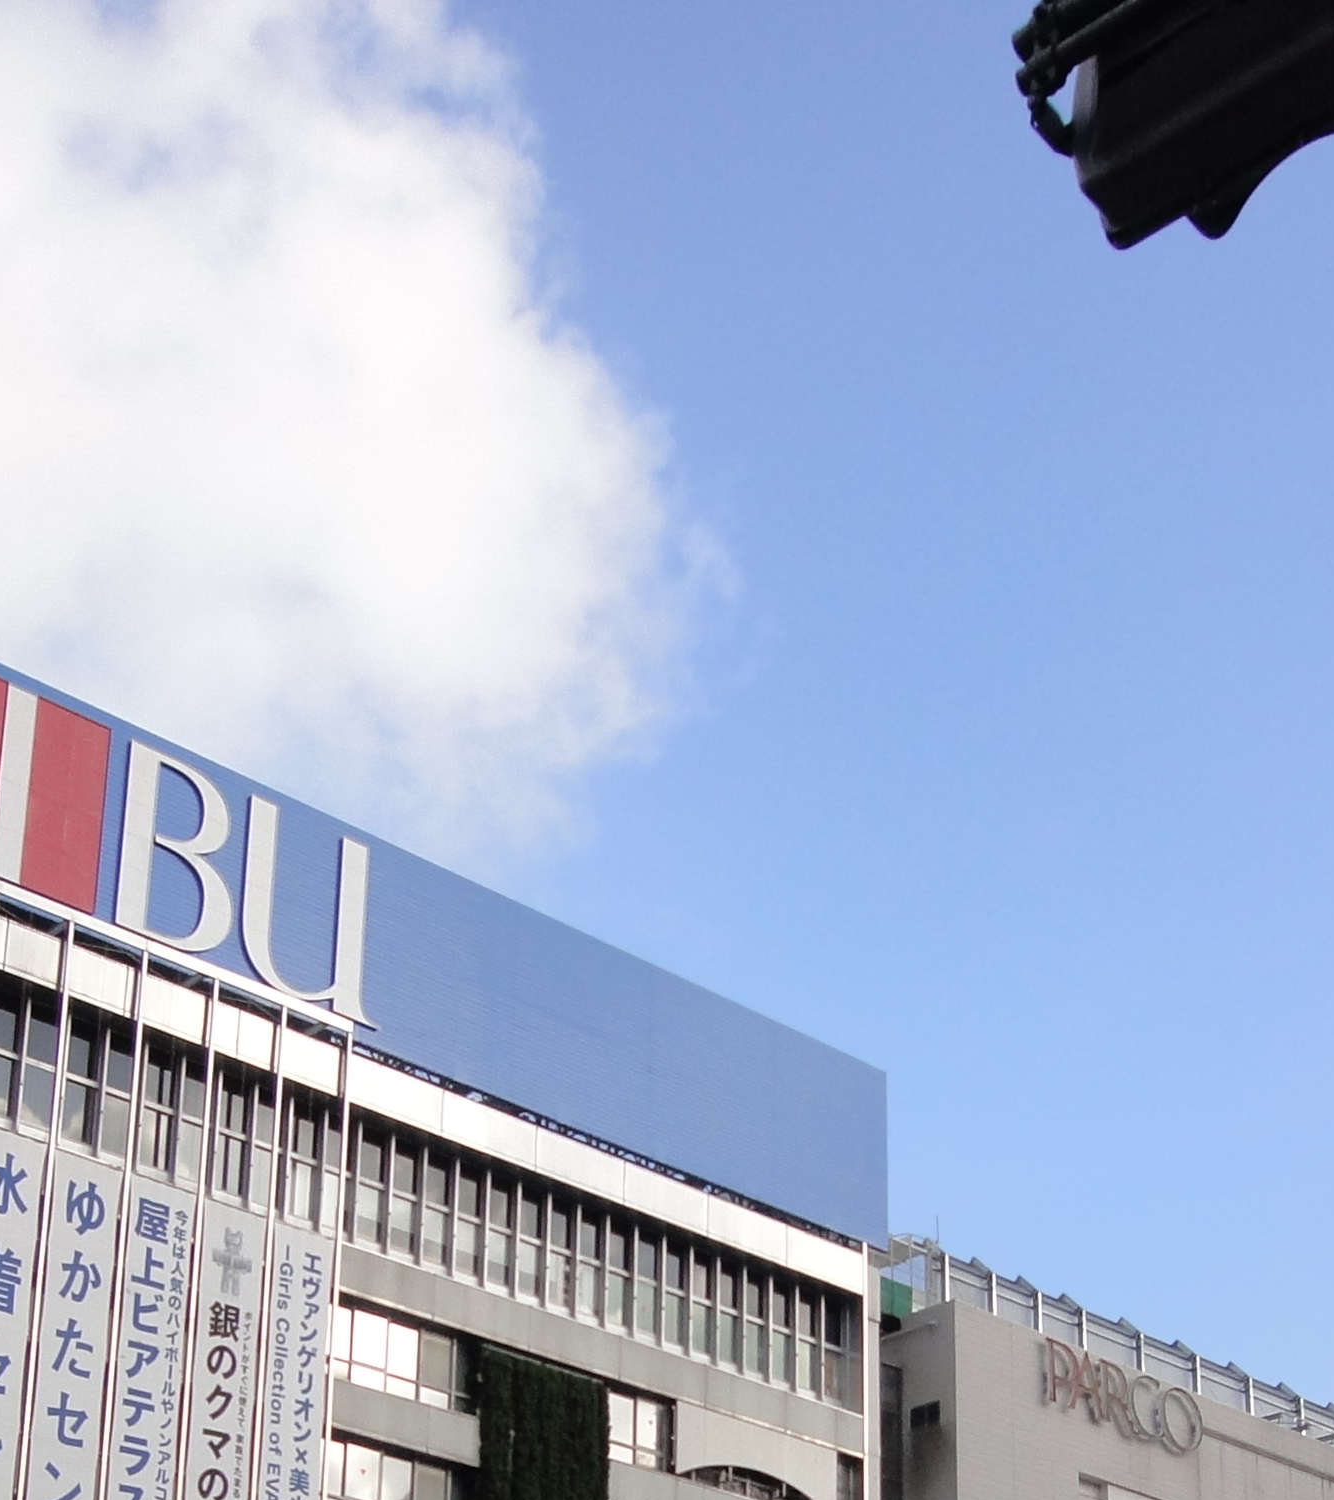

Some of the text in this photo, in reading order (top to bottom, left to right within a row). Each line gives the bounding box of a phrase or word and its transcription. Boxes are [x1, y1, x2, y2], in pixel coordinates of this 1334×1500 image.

[269, 1319, 291, 1424] Collection
[1045, 1336, 1204, 1453] PARCO
[269, 1432, 280, 1455] of
